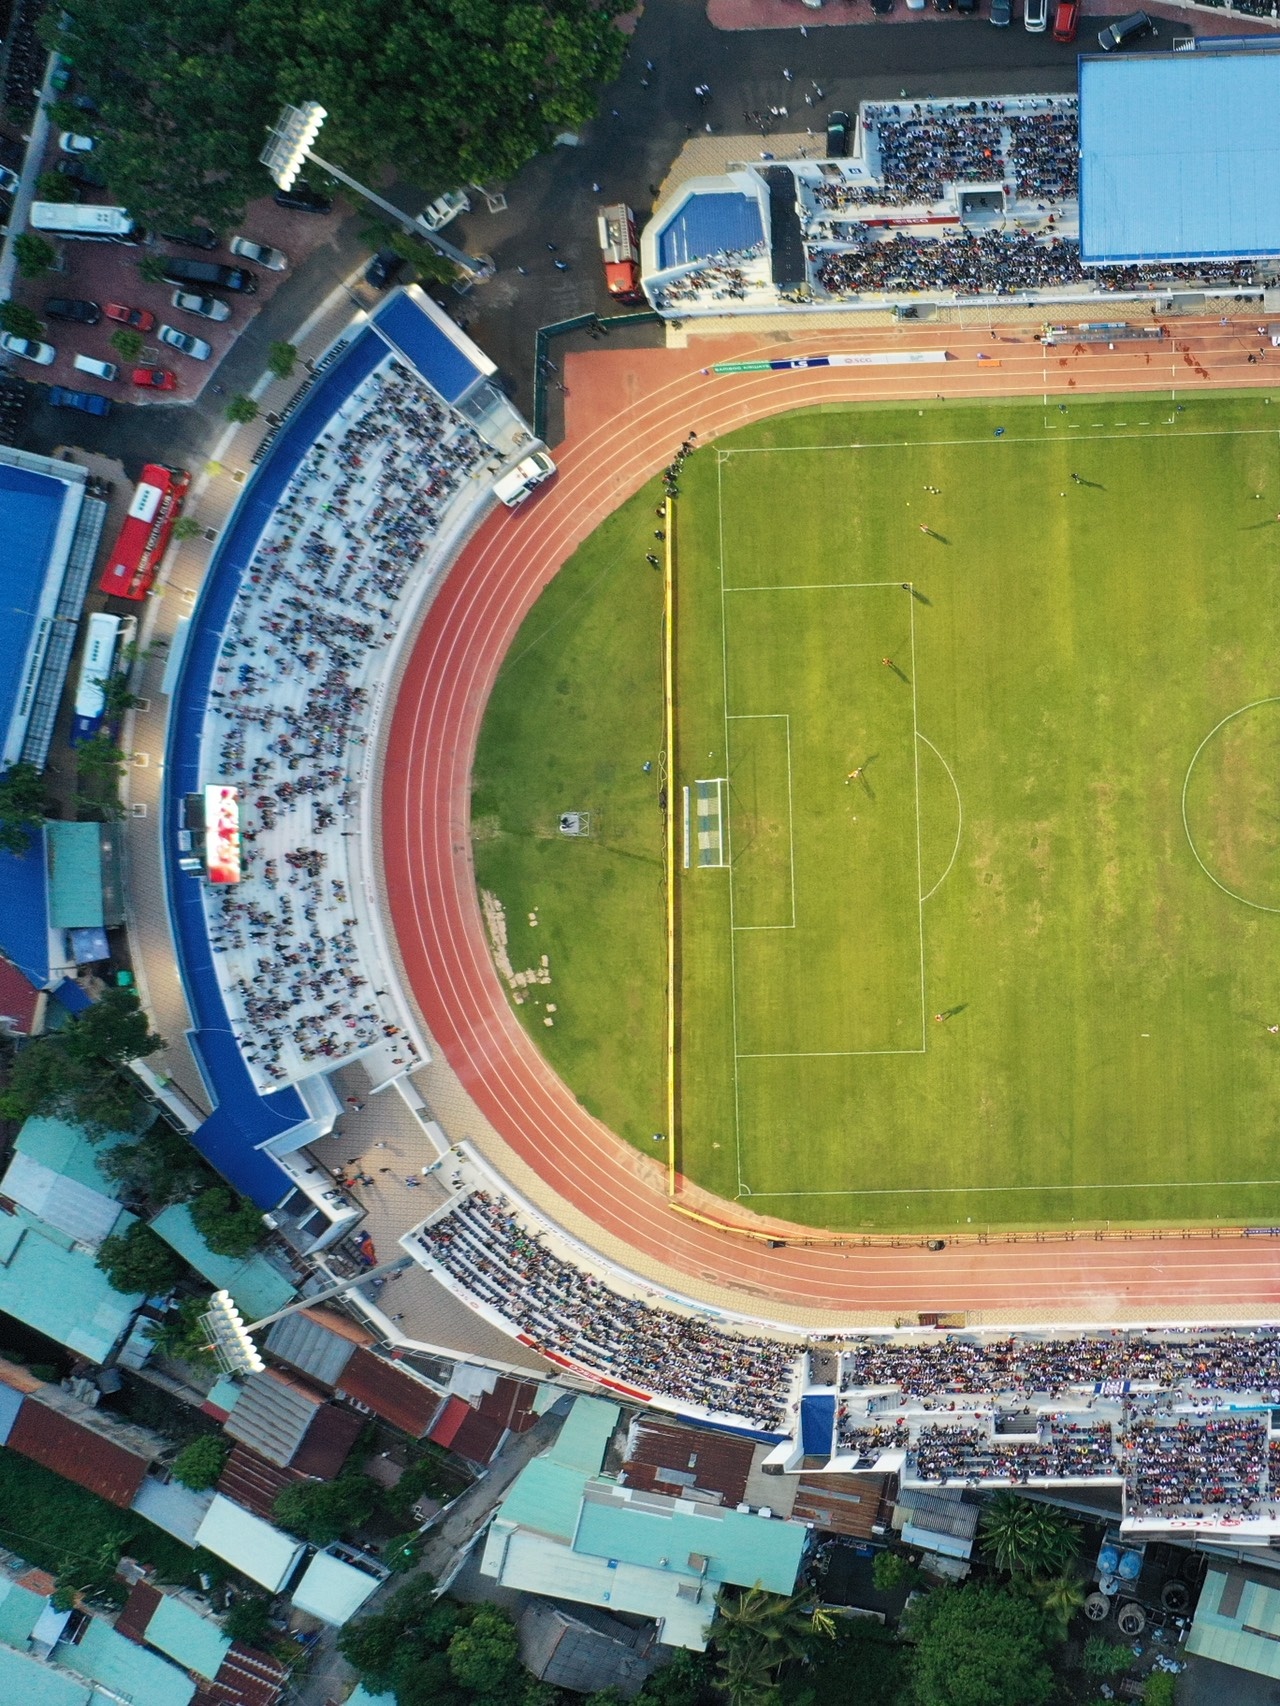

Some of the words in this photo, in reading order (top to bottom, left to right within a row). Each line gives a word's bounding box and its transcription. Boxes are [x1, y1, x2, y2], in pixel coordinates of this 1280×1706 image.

[790, 360, 808, 369] LS
[144, 515, 164, 551] FOOTBALL
[158, 494, 172, 515] CLUB
[1169, 1520, 1213, 1528] SCG
